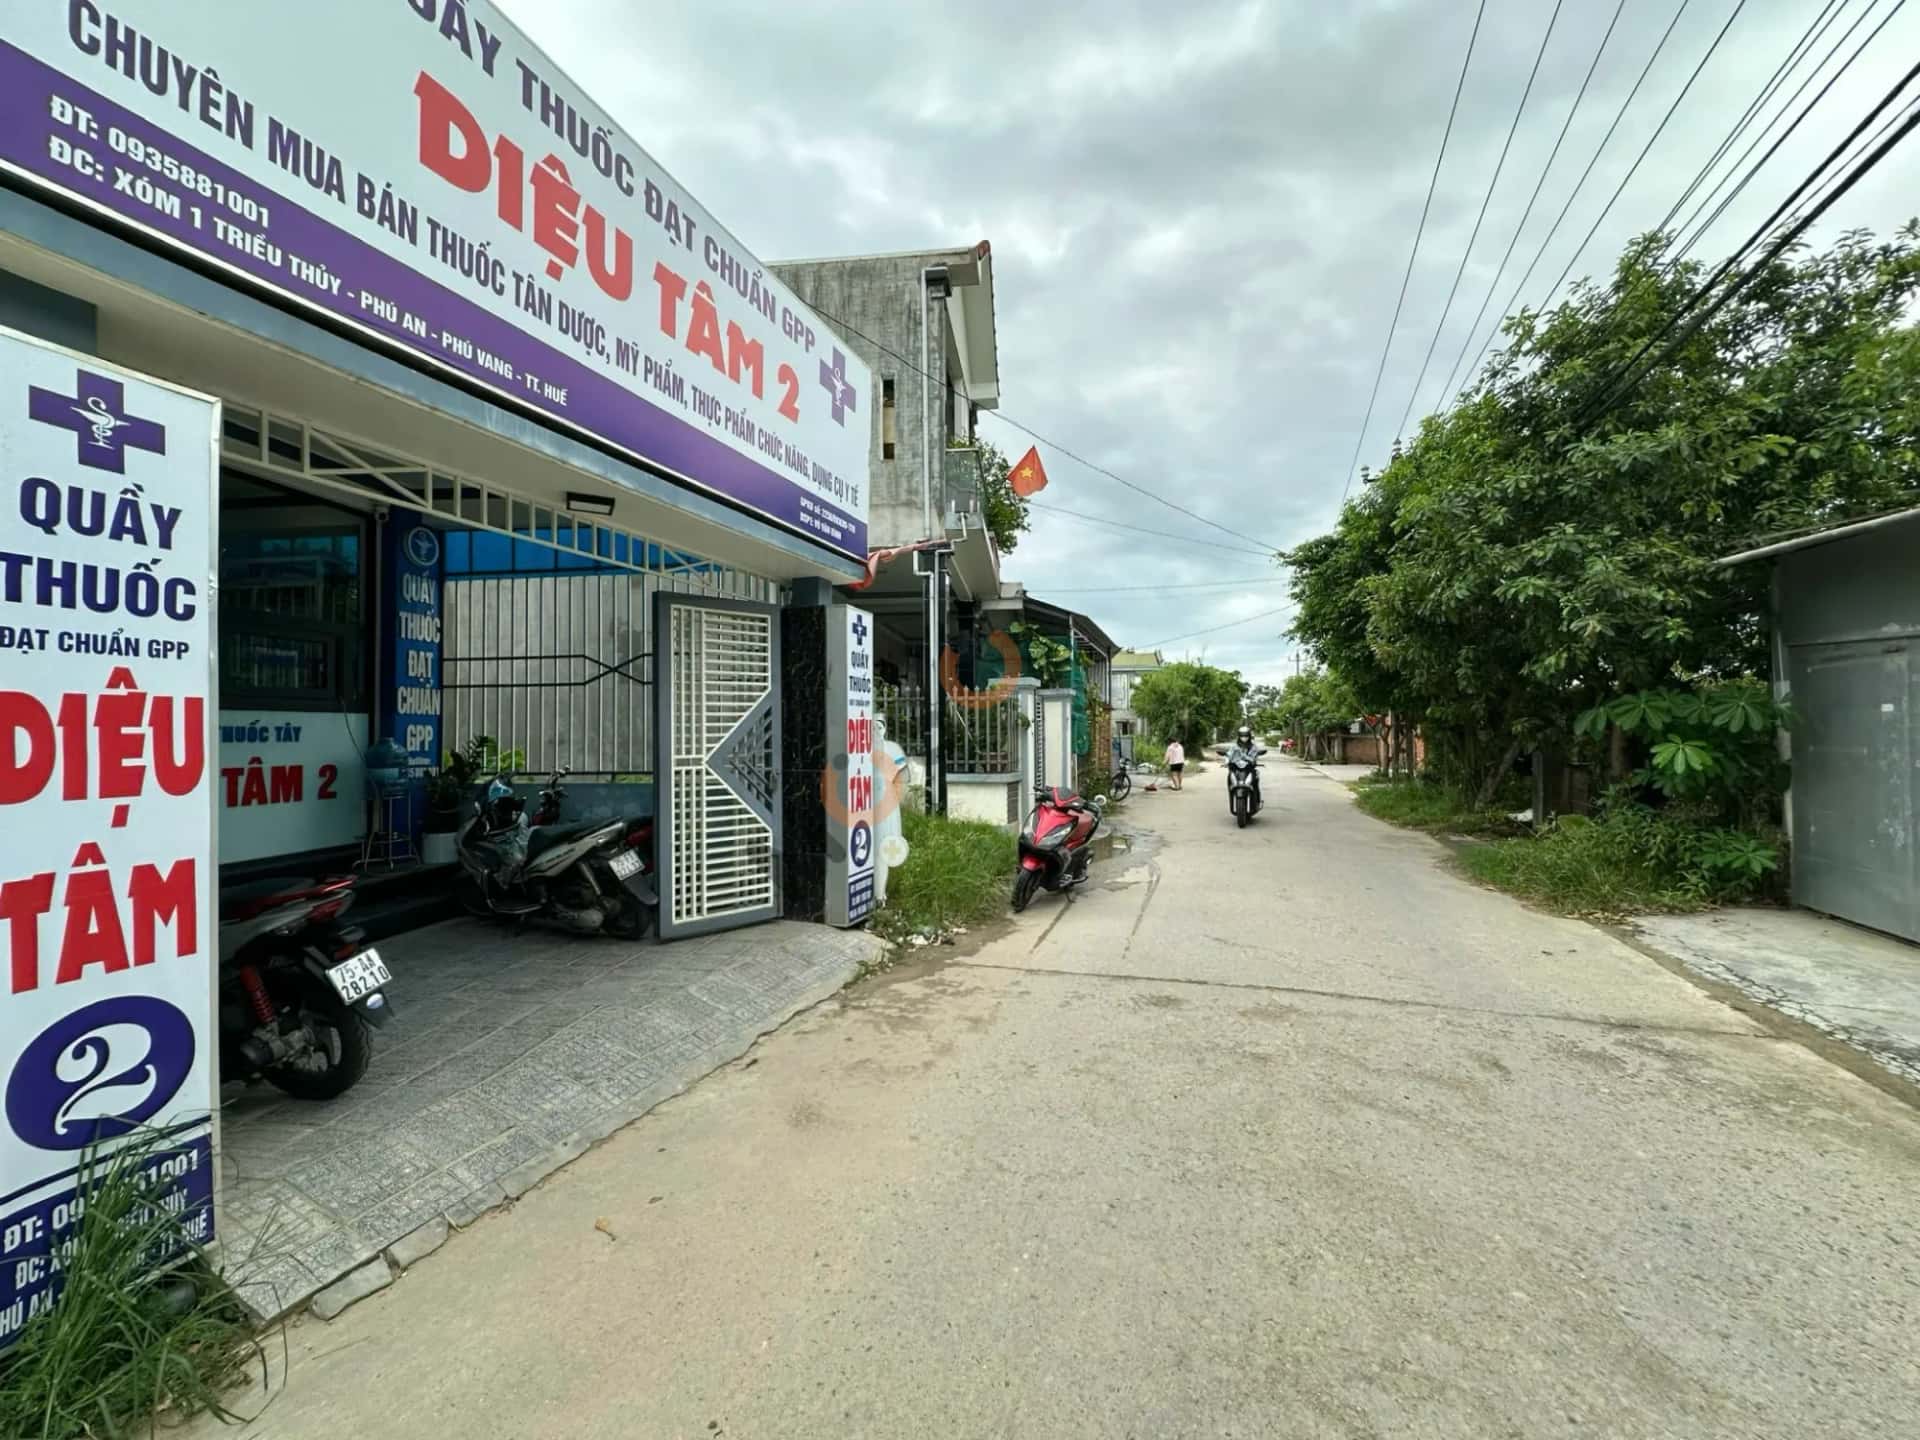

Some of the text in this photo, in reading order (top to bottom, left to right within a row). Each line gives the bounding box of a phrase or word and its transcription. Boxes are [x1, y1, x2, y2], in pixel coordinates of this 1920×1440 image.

[50, 94, 269, 228] ĐT: 0935881001
[516, 57, 634, 197] THUỐC
[644, 177, 696, 251] ĐẠT
[704, 236, 776, 324] CHUẨN
[782, 305, 815, 353] GPP
[49, 135, 104, 183] ĐC:
[113, 166, 181, 220] XÓM
[189, 206, 202, 229] 1
[289, 253, 342, 296] THỦY
[361, 290, 398, 323] PHÚ
[402, 312, 427, 338] AN
[442, 331, 473, 359] PHÚ
[477, 348, 513, 380] VANG
[525, 373, 541, 393] TT.
[544, 382, 568, 406] HUẾ
[68, 0, 254, 150] CHUYÊN
[268, 116, 346, 204] MUA
[357, 172, 418, 247] BÁN
[427, 216, 505, 296] THUỐC
[512, 270, 551, 326] TÂN
[558, 300, 610, 364] DƯỢC,
[616, 337, 640, 377] MỸ
[691, 384, 722, 427] THỰC
[724, 405, 756, 446] PHẨM
[844, 482, 851, 502] Y
[413, 70, 800, 424] DIỆU TÂM 2
[20, 476, 182, 550] QUẦY
[0, 552, 197, 621] THUỐC
[0, 627, 189, 660] ĐẠT CHUẨN GPP
[400, 608, 440, 643] THUỐC
[408, 650, 433, 683] ĐẠT
[397, 679, 440, 716] CHUẨN
[0, 666, 205, 828] DIỆU
[219, 719, 302, 743] HUỐC TÂY
[406, 724, 433, 752] GPP
[848, 710, 872, 764] DIỆU
[221, 756, 338, 808] TÂM 2
[849, 768, 872, 813] TÂM
[0, 842, 197, 995] TÂM
[55, 1023, 157, 1135] 2
[3, 1215, 43, 1254] ĐT:
[15, 1257, 45, 1290] ĐC:
[0, 1296, 23, 1338] HÚ
